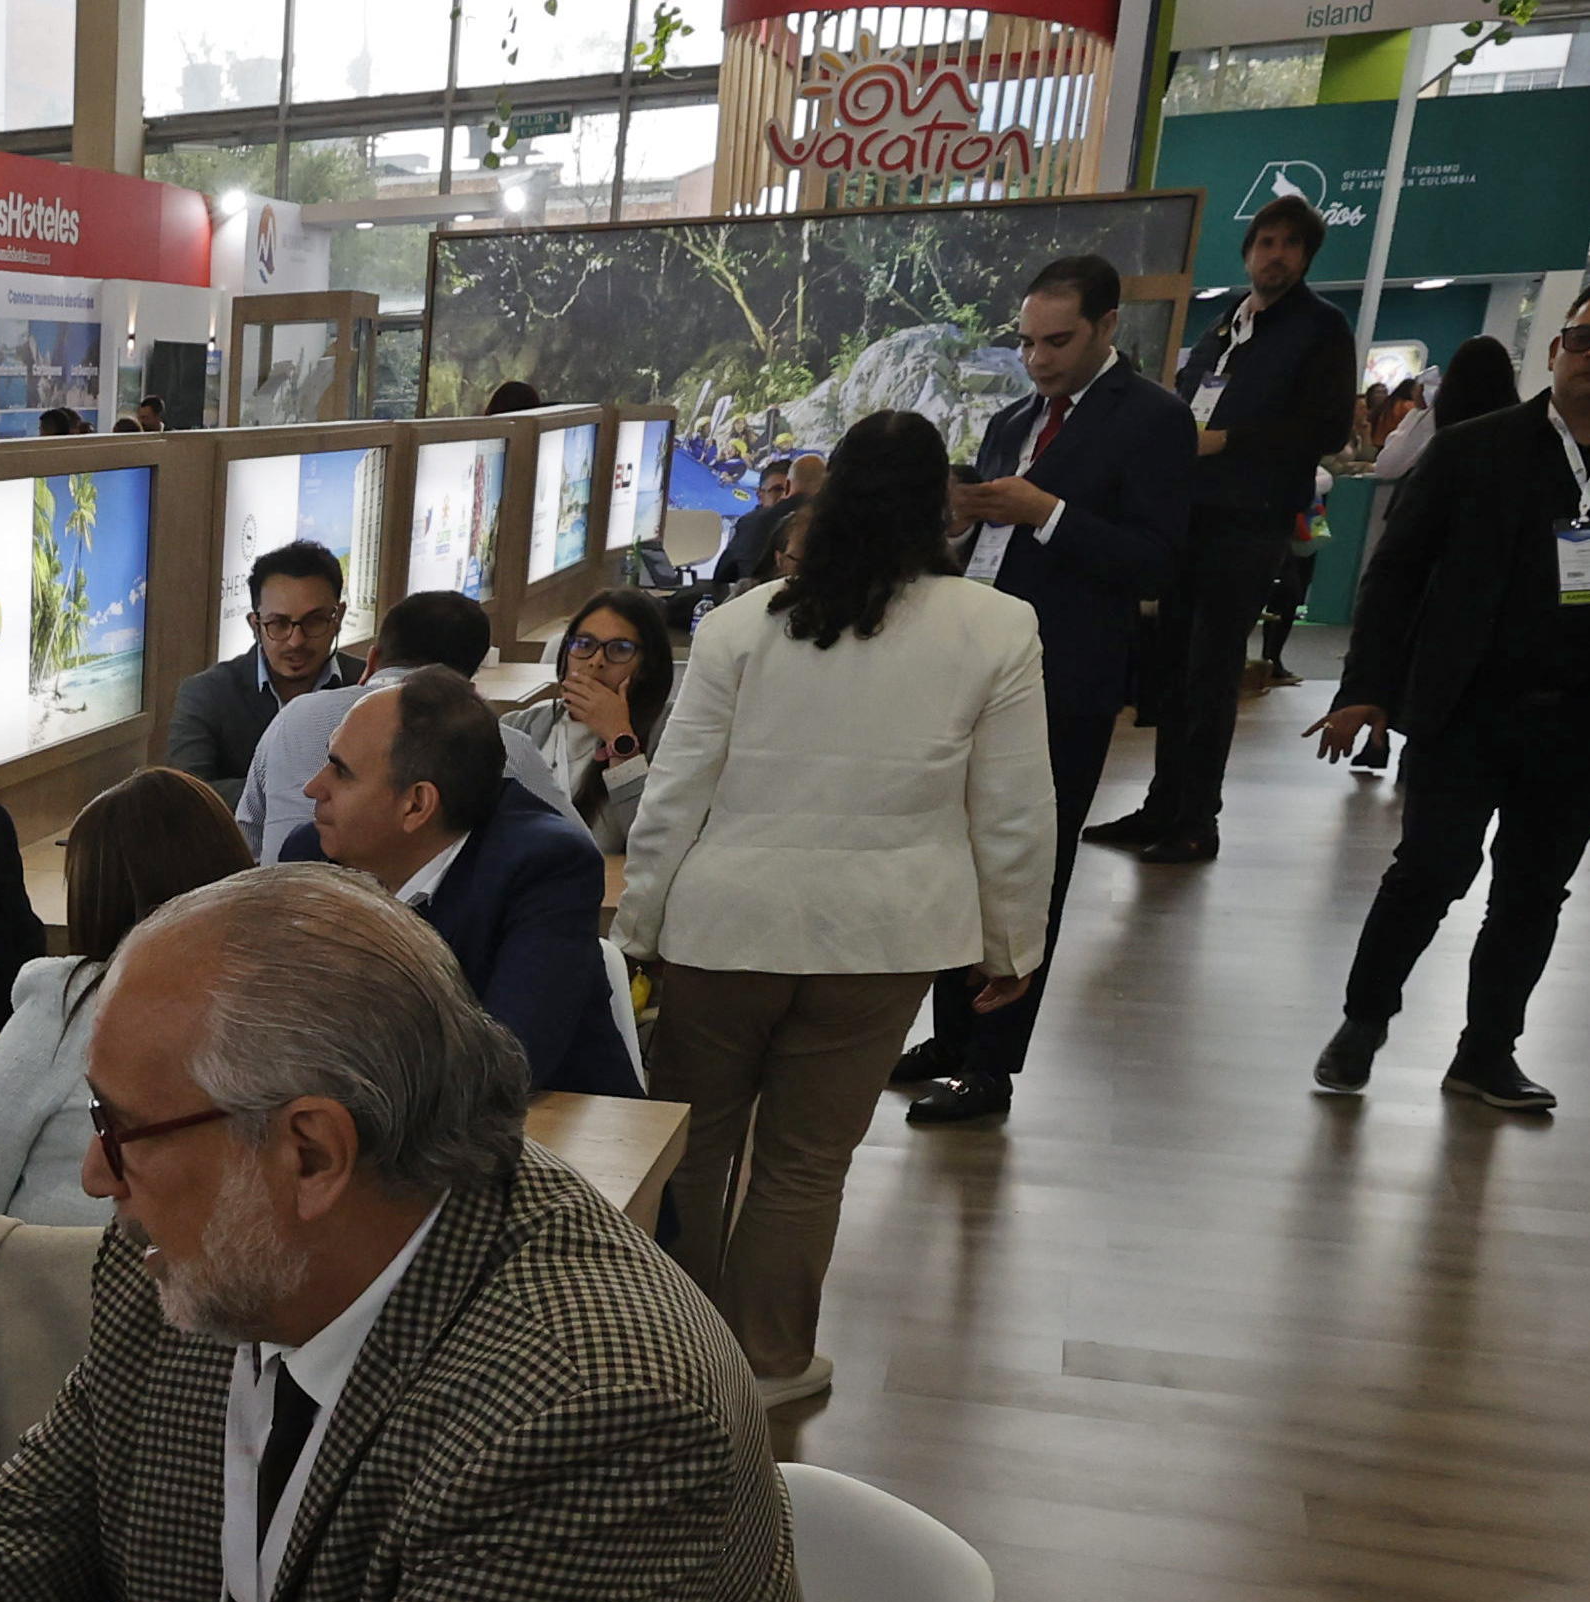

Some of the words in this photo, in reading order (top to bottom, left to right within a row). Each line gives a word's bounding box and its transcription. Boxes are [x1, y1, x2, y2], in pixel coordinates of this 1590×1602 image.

[1305, 0, 1374, 29] island
[1419, 174, 1477, 187] COLOMBIA
[220, 572, 250, 600] SHER
